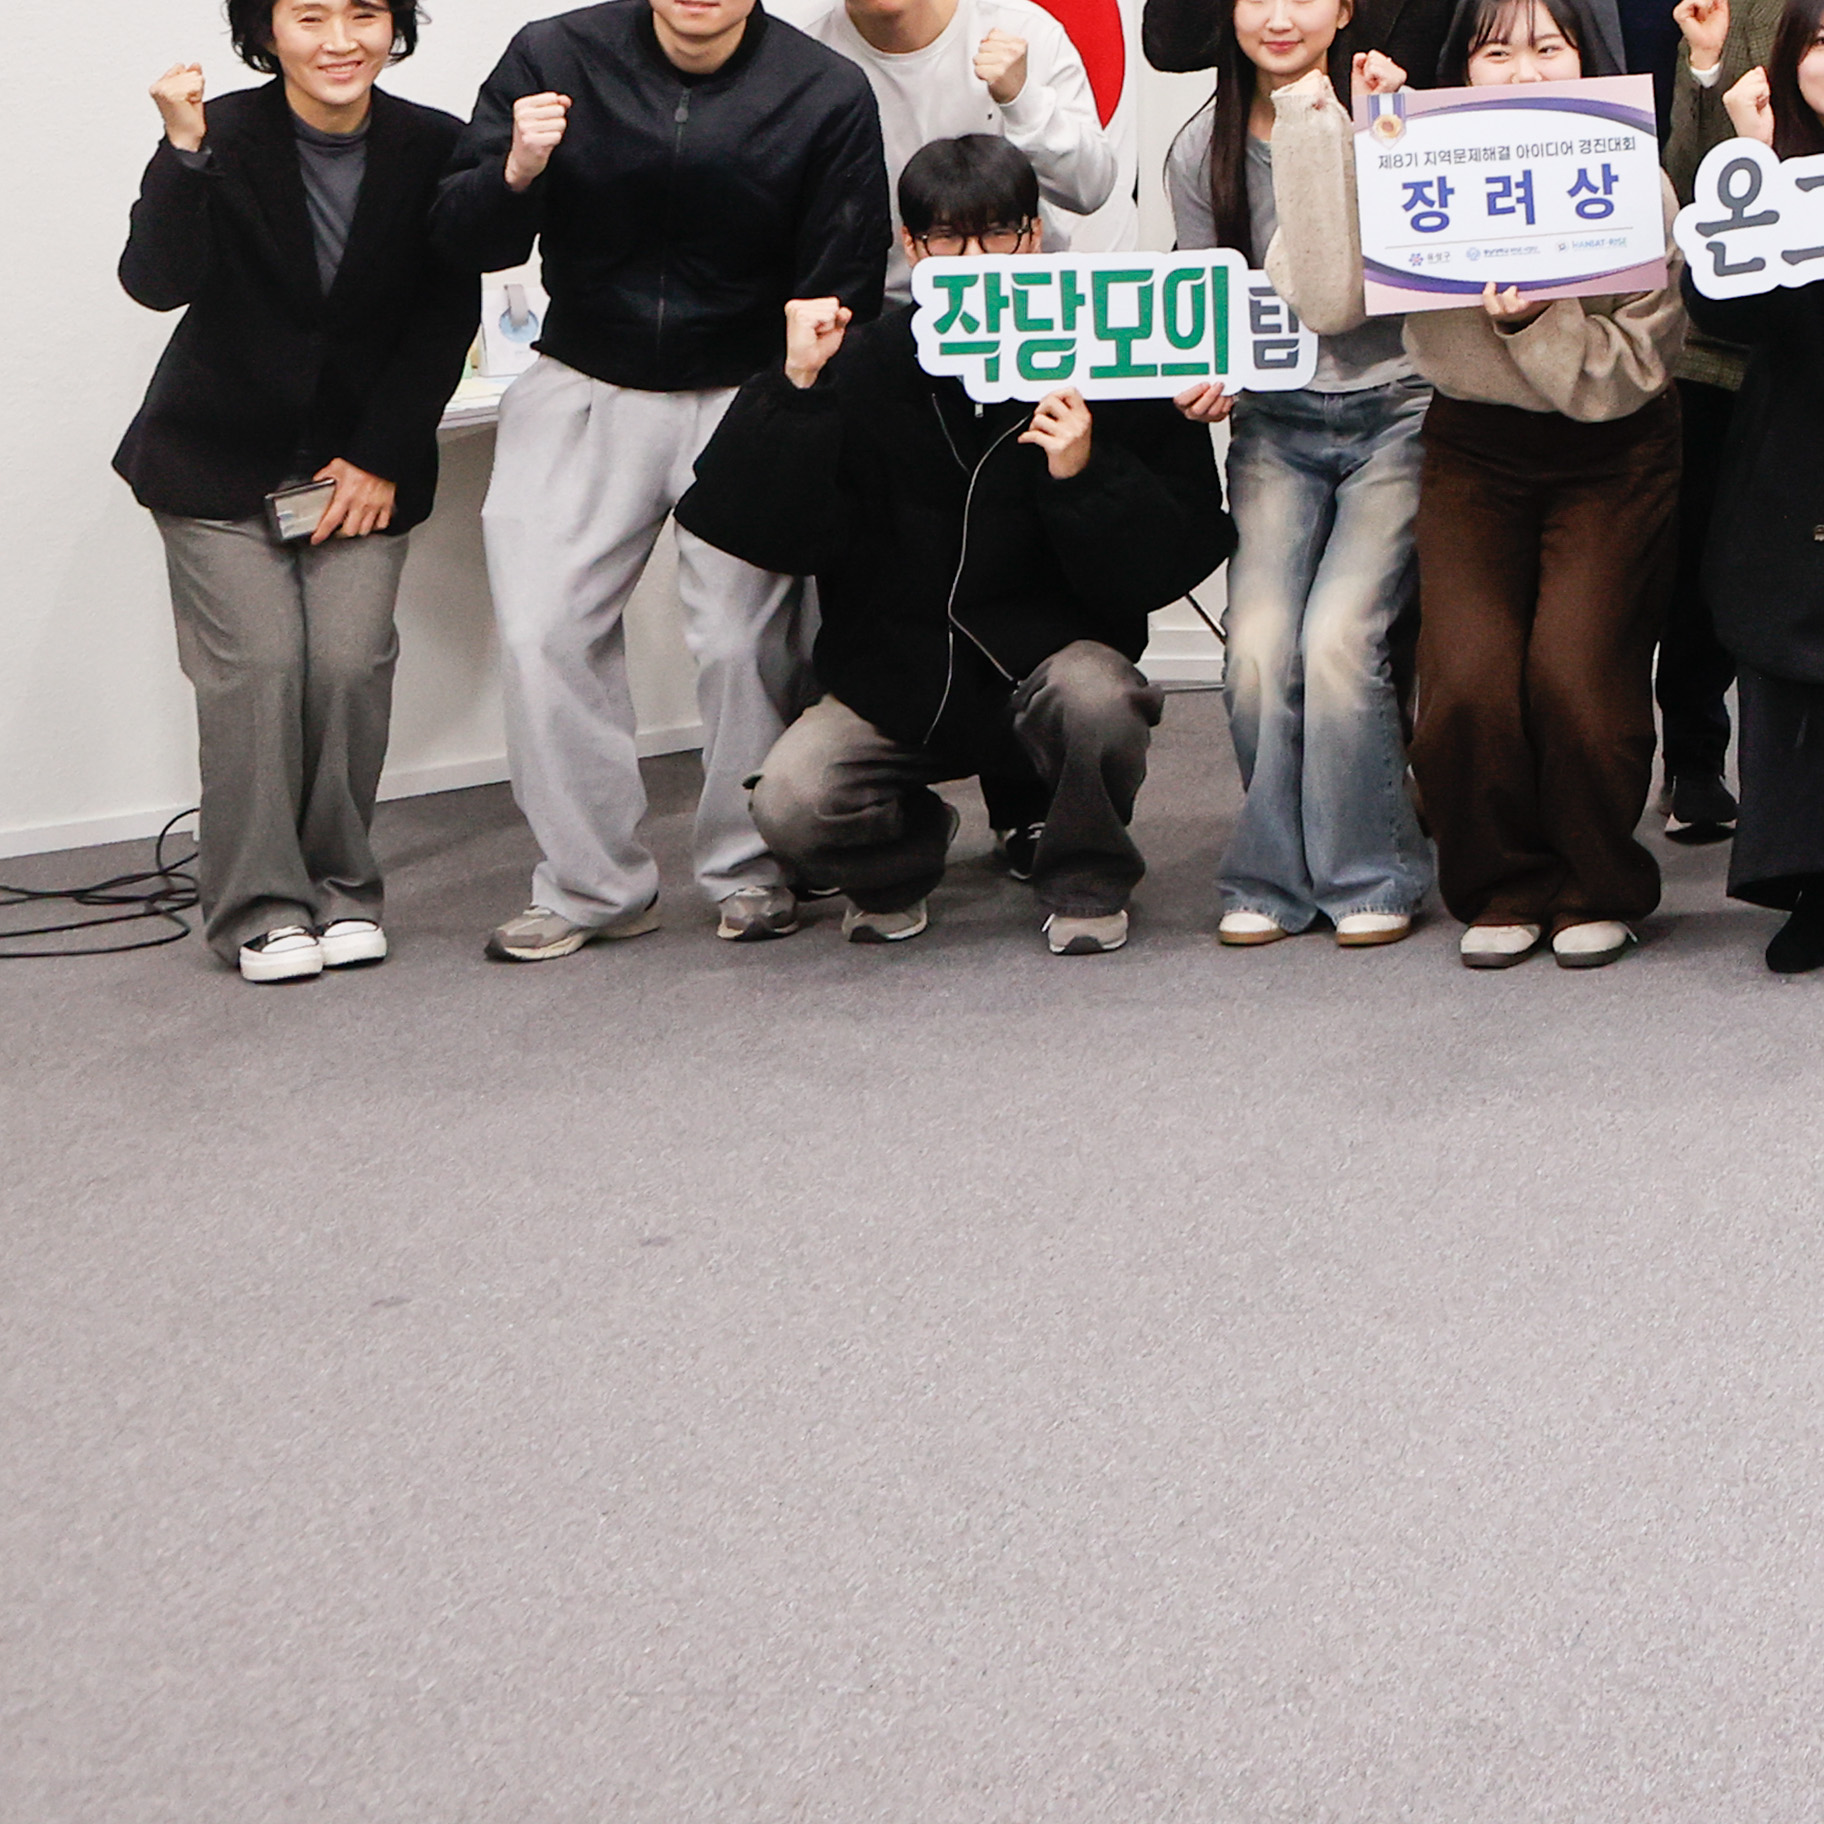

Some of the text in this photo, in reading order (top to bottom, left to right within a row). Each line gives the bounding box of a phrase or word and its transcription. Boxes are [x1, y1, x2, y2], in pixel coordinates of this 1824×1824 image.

[1378, 135, 1637, 169] 제8기 지역문제해결 아이디어 경진대회
[930, 264, 1301, 384] 작당모의 팀
